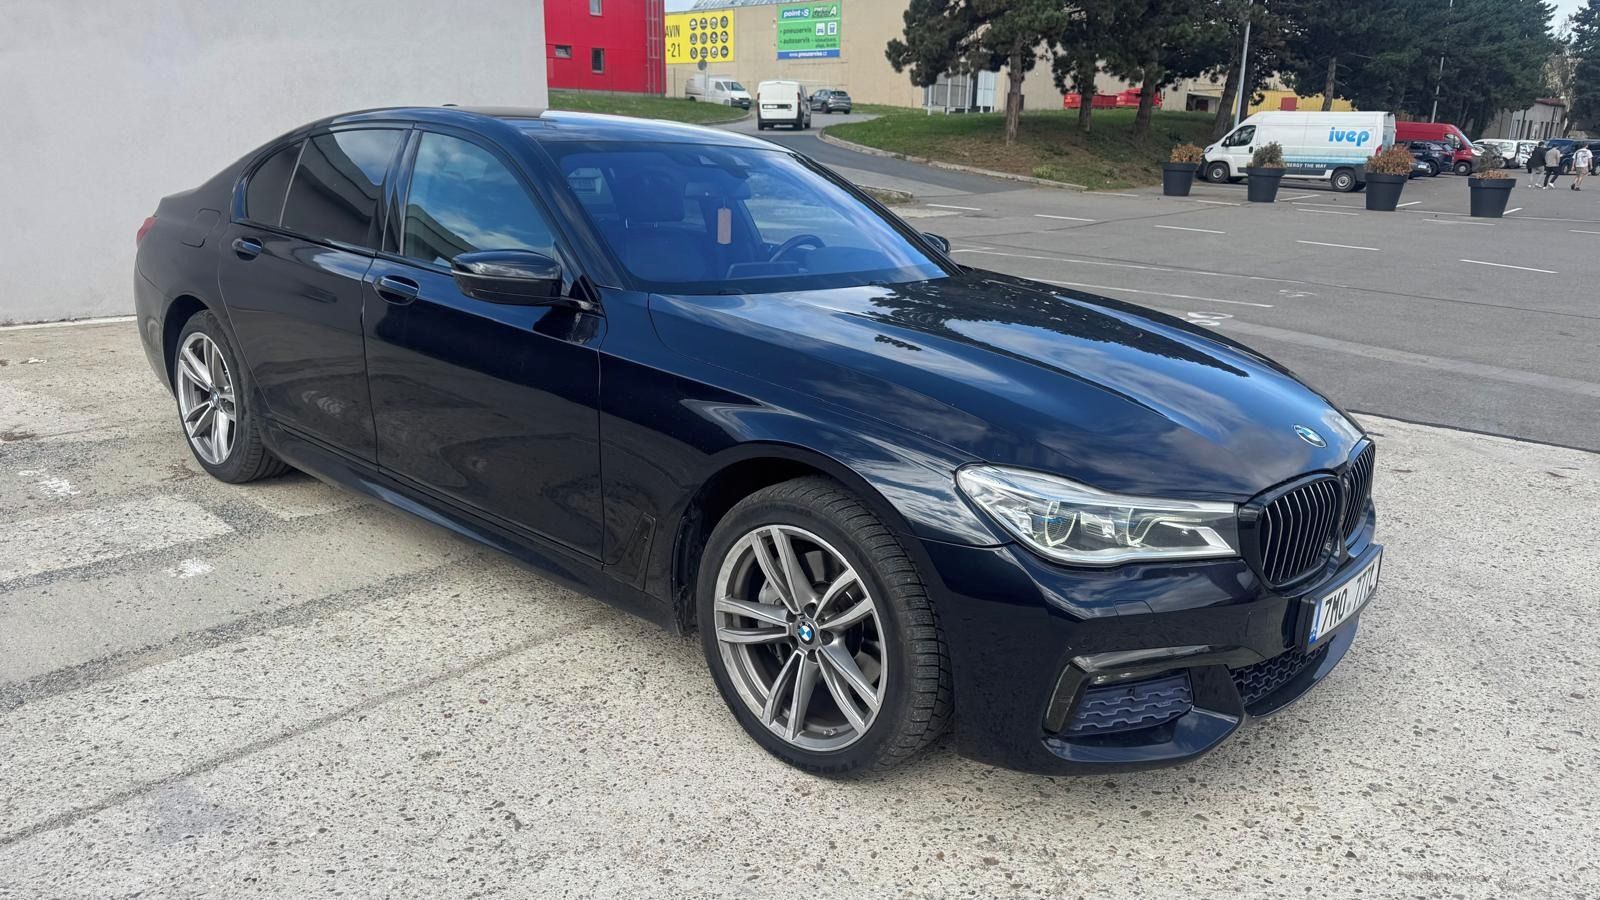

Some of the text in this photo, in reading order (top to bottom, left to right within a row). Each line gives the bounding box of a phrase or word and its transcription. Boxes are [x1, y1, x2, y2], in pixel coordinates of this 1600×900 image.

[666, 25, 680, 38] AVIN
[667, 42, 680, 57] -21
[1328, 126, 1370, 147] ivep
